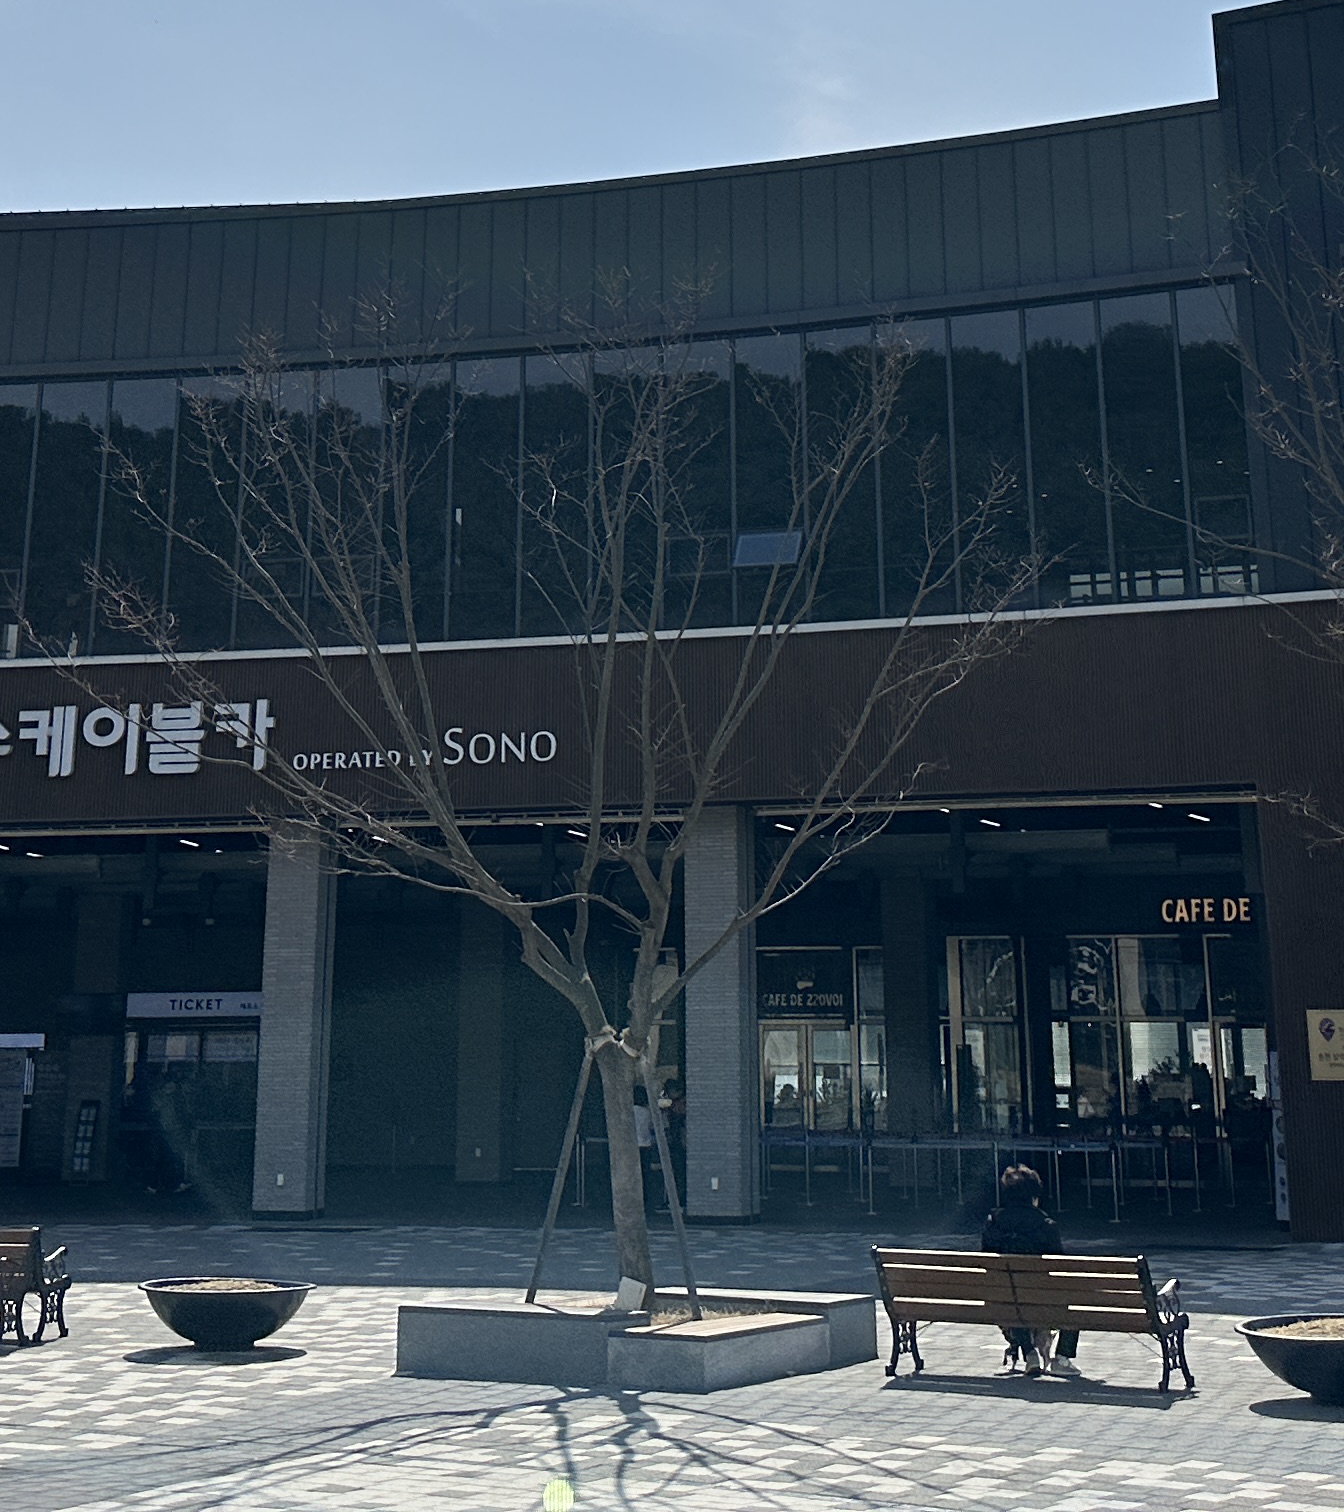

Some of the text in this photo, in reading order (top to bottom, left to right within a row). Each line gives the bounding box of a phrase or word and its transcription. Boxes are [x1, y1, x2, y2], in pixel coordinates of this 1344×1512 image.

[292, 750, 401, 771] OPERATED
[442, 727, 557, 765] SONO
[1160, 897, 1251, 923] CAFE DE
[169, 998, 224, 1011] TICKET
